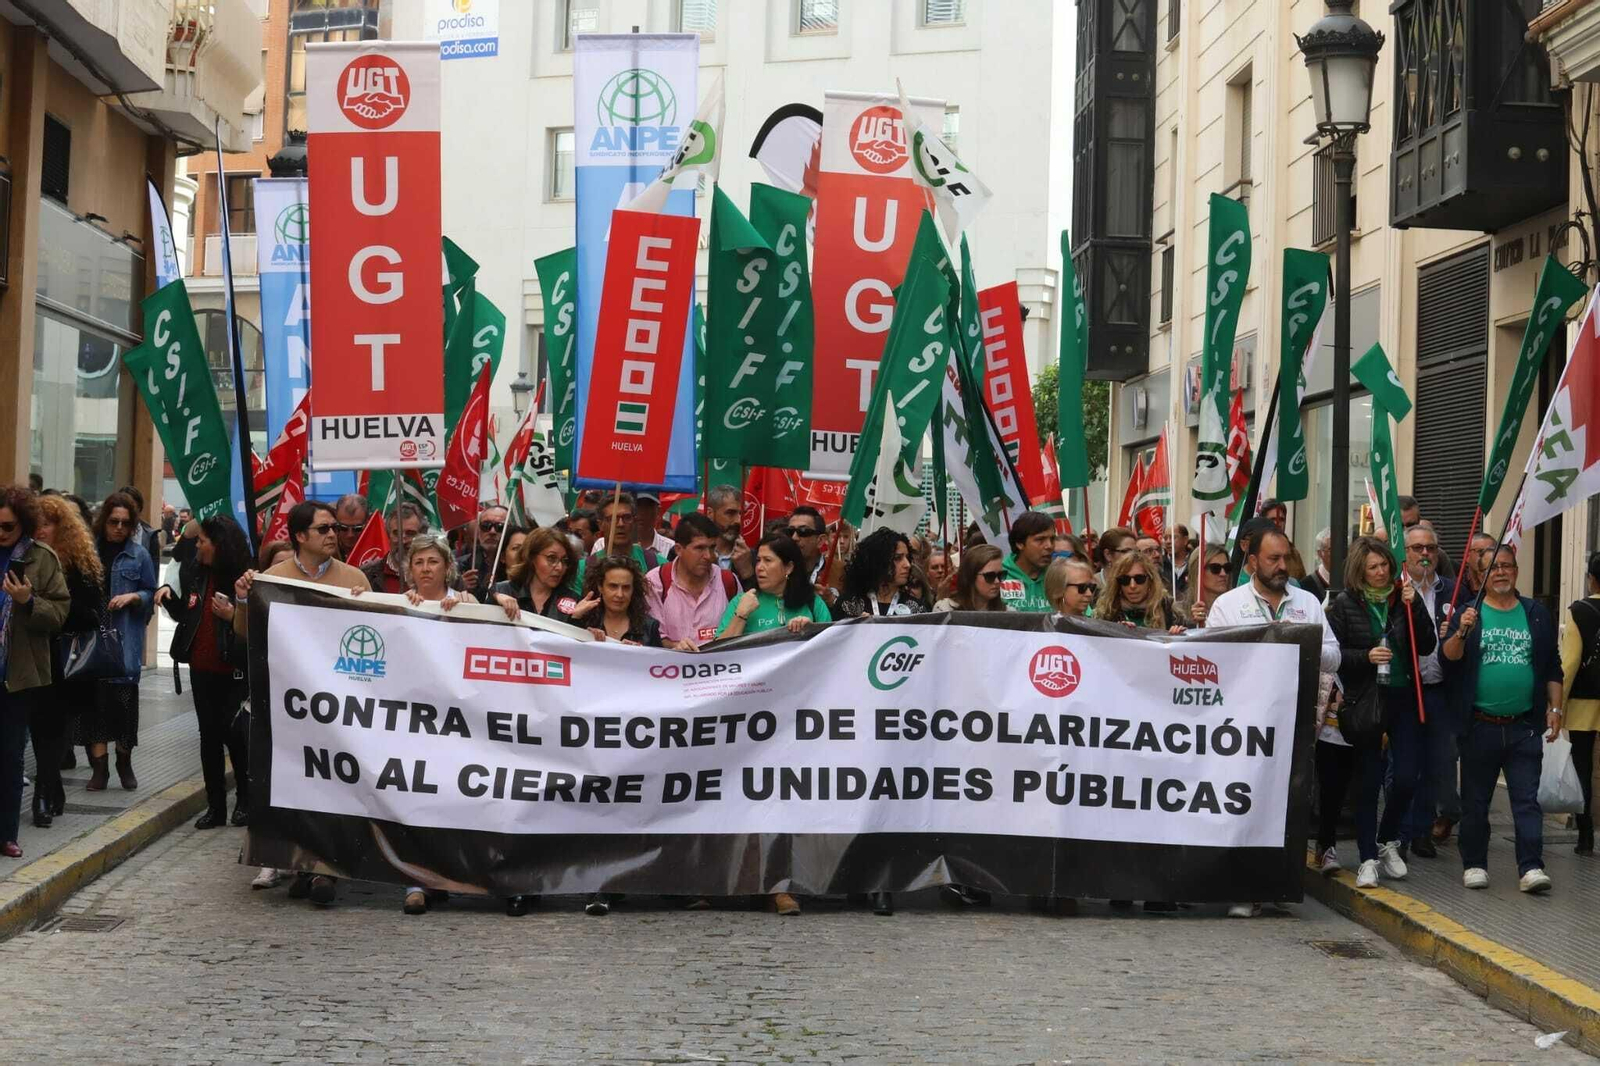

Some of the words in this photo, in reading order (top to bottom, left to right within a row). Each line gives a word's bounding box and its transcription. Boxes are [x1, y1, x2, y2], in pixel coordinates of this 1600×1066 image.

[438, 13, 485, 34] prodisa
[346, 67, 401, 93] UGT
[590, 126, 680, 151] ANPE
[859, 115, 906, 144] UGT
[348, 156, 404, 391] UGT
[619, 235, 672, 395] CCOO
[845, 197, 898, 412] UGT
[981, 306, 1018, 438] CCOO
[321, 416, 436, 440] HUELVA
[611, 441, 643, 452] HUELVA
[333, 656, 387, 675] ANPE
[470, 654, 544, 677] CCOO
[880, 652, 925, 673] CSIF
[1036, 654, 1074, 675] UGT
[1173, 663, 1217, 675] HUELVA
[1173, 688, 1223, 706] USTEA
[284, 688, 471, 738] CONTRA
[487, 712, 542, 746] EL
[560, 711, 777, 748] DECRETO
[795, 709, 855, 741] DE
[875, 708, 1275, 757] ESCOLARIZACIÓN
[303, 746, 361, 784] NO
[376, 757, 438, 794] AL
[457, 764, 645, 803] CIERRE
[662, 768, 722, 804] DE
[742, 766, 993, 802] UNIDADES
[1012, 763, 1251, 816] PÚBLICAS
